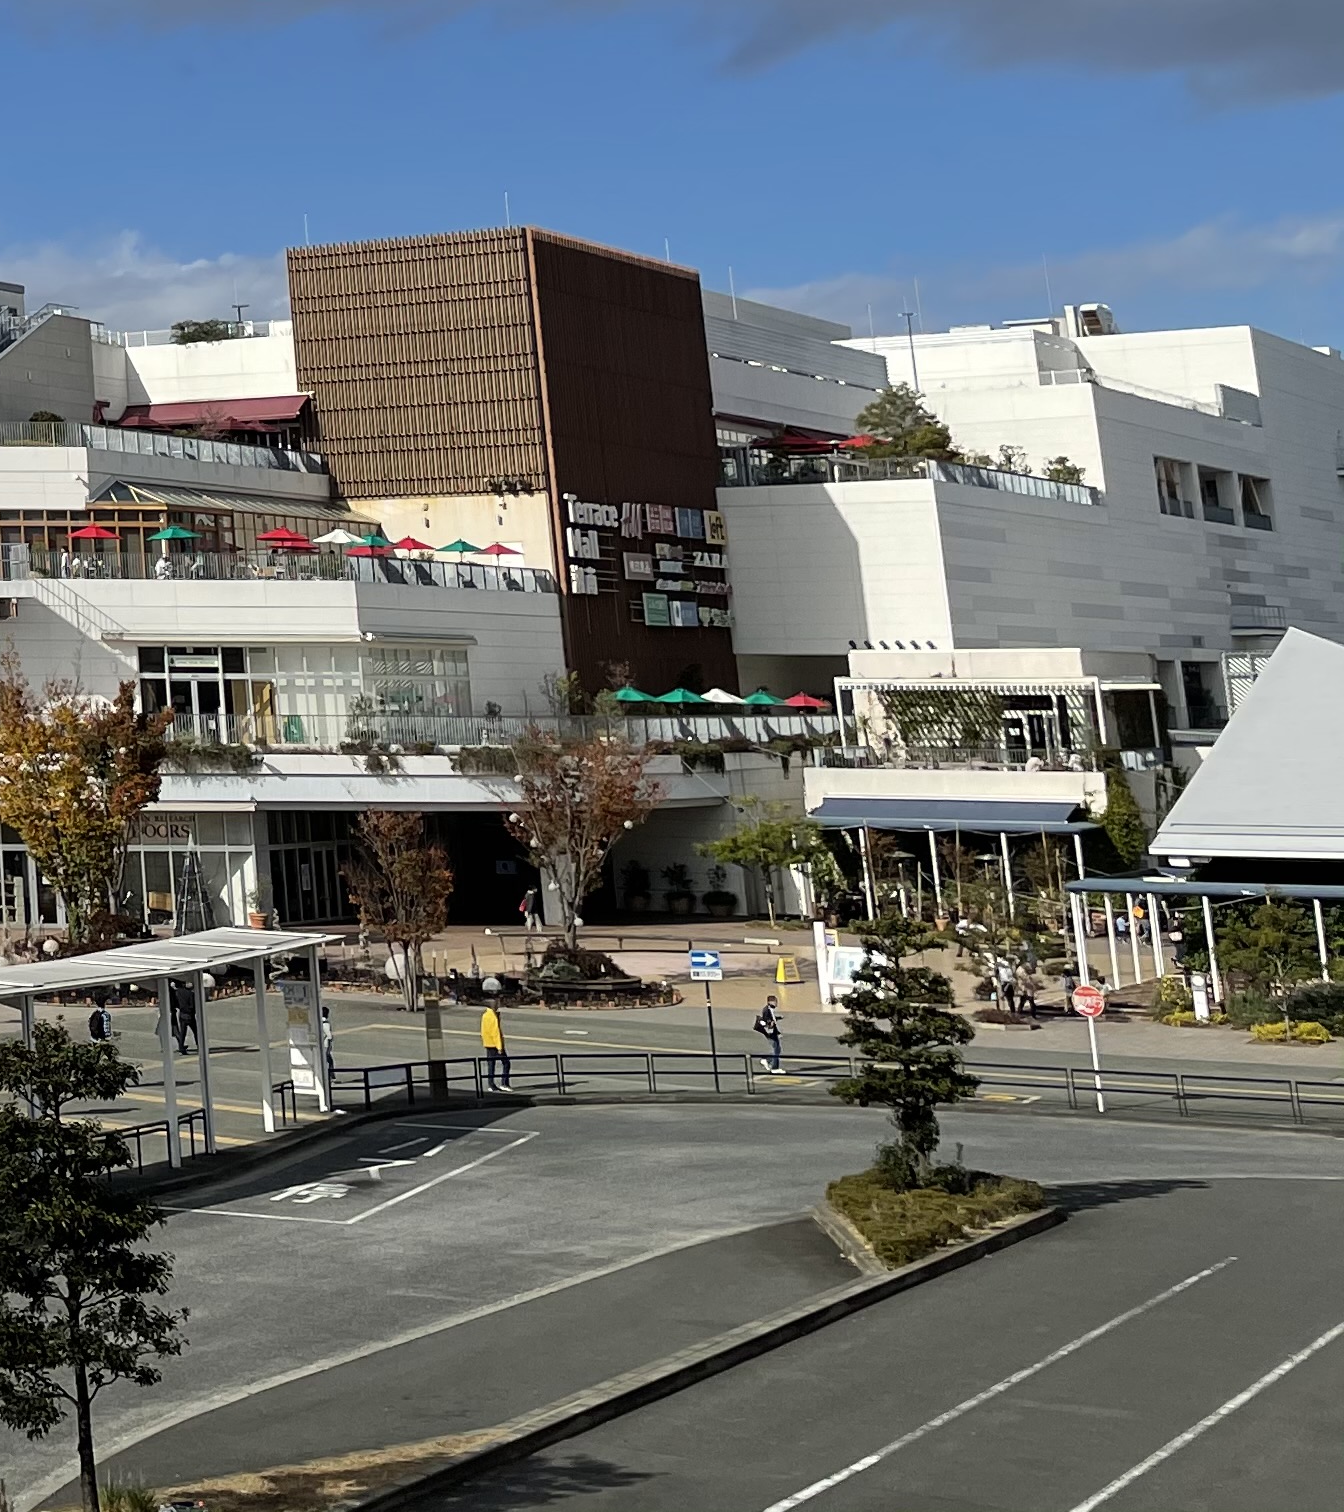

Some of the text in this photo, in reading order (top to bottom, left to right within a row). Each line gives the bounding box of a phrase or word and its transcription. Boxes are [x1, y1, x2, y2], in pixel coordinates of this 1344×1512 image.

[563, 493, 619, 527] Terrace
[567, 527, 600, 559] Mall
[693, 551, 729, 568] ZARA
